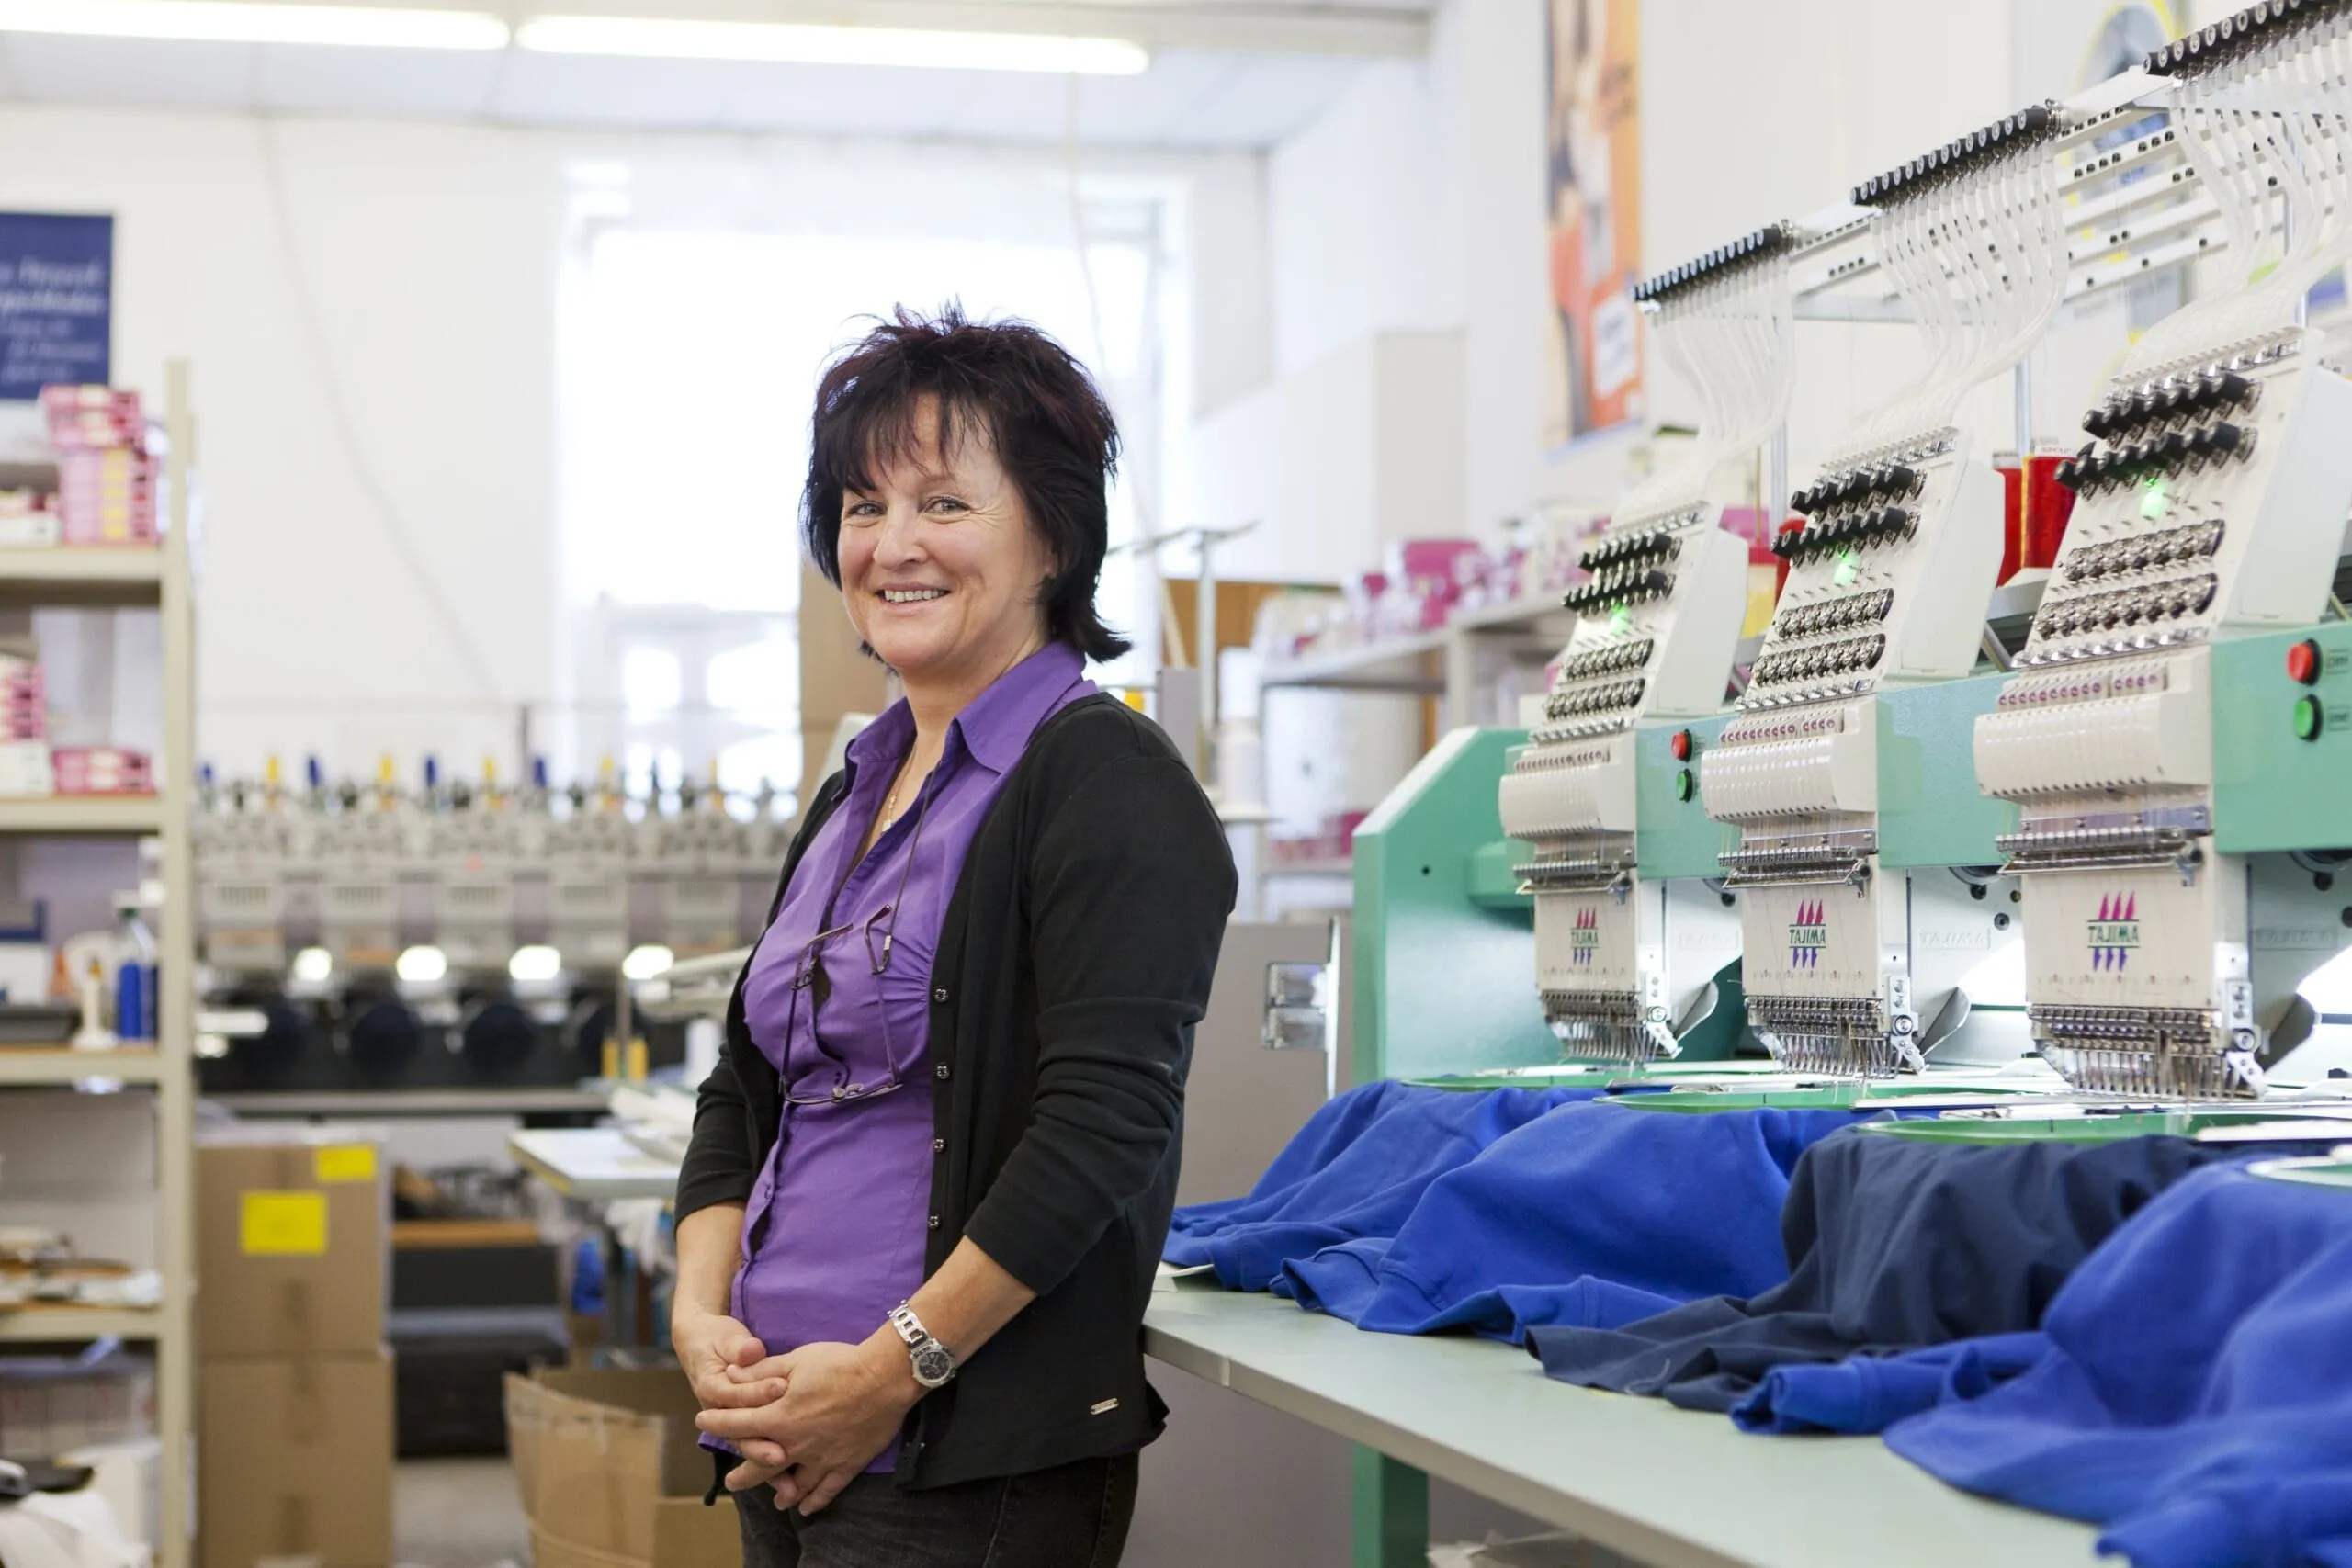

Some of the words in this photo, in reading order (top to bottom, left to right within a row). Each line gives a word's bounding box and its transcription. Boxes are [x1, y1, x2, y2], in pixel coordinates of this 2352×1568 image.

[1571, 931, 1599, 944] TAJIMA
[1789, 929, 1826, 944] TAJIMA
[2088, 925, 2139, 942] TAJIMA
